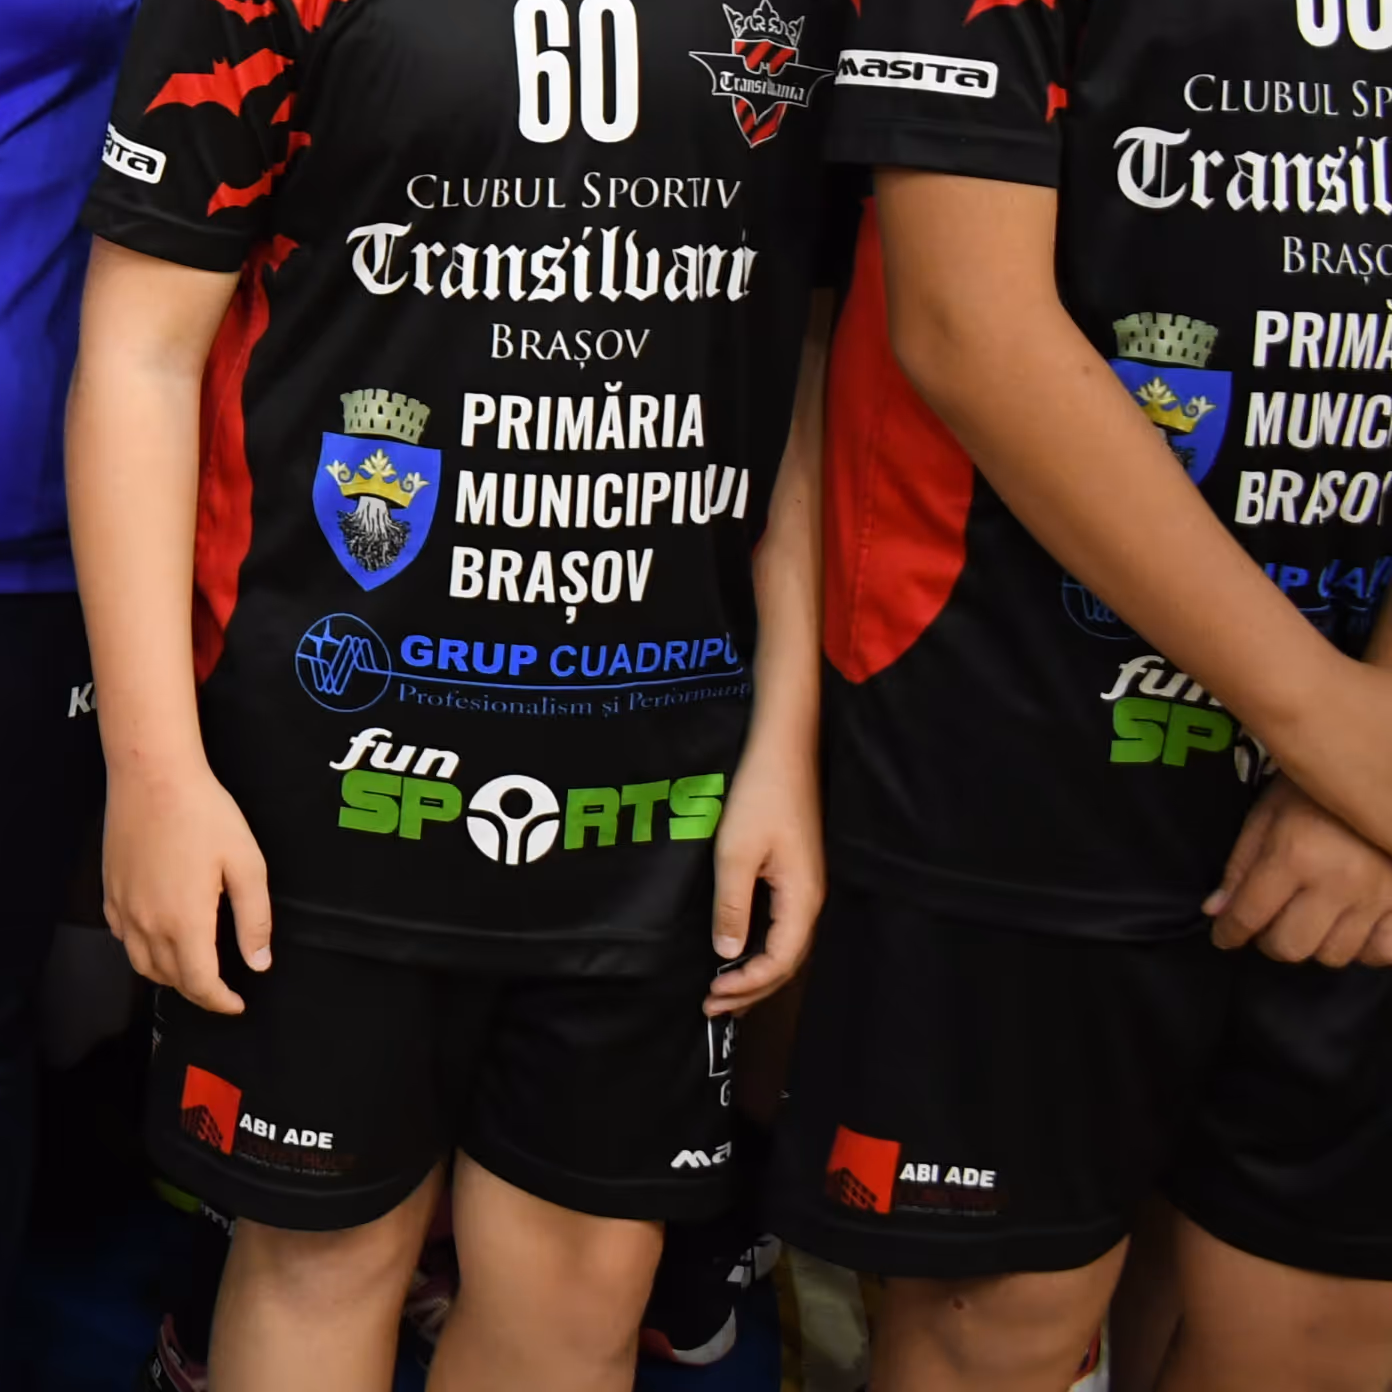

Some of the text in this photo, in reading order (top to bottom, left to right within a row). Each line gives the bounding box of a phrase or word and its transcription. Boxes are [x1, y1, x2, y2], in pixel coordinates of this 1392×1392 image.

[460, 381, 705, 451] PRIMĂRIA
[448, 545, 654, 624] BRAȘOV
[399, 634, 538, 676] GRUP
[398, 682, 593, 717] Profesionalism
[328, 726, 461, 779] fun
[238, 1112, 334, 1150] ABI ADE
[899, 1162, 996, 1188] ABI ADE
